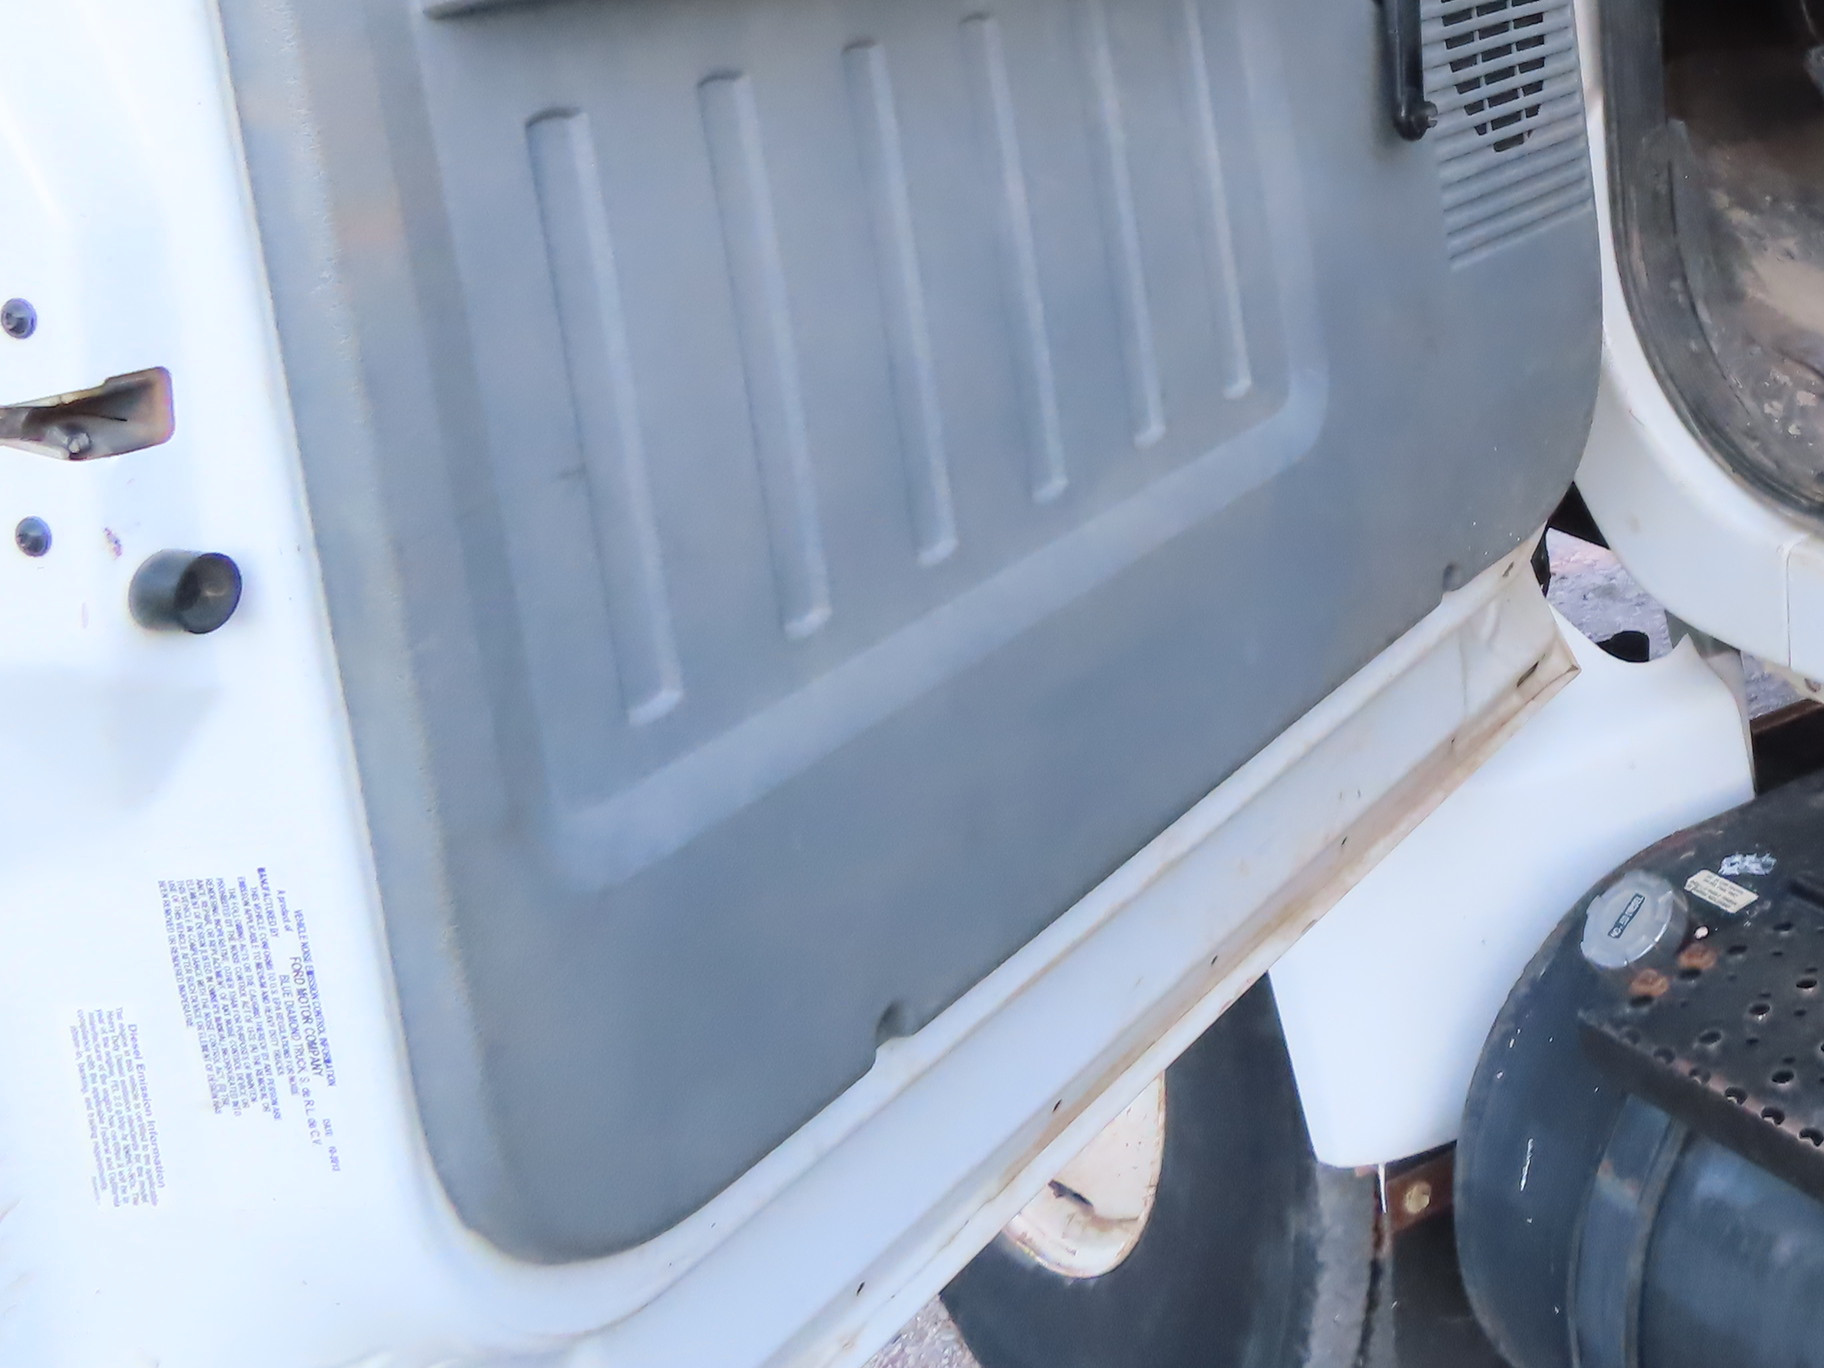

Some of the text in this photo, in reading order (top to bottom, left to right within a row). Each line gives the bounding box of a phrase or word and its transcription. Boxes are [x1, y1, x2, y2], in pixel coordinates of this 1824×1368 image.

[278, 974, 293, 997] BLUE
[284, 1000, 301, 1040] DIAMOND
[290, 956, 322, 1075] FORD MOTOR COMPANY
[127, 1023, 164, 1187] Diesel Emission Information
